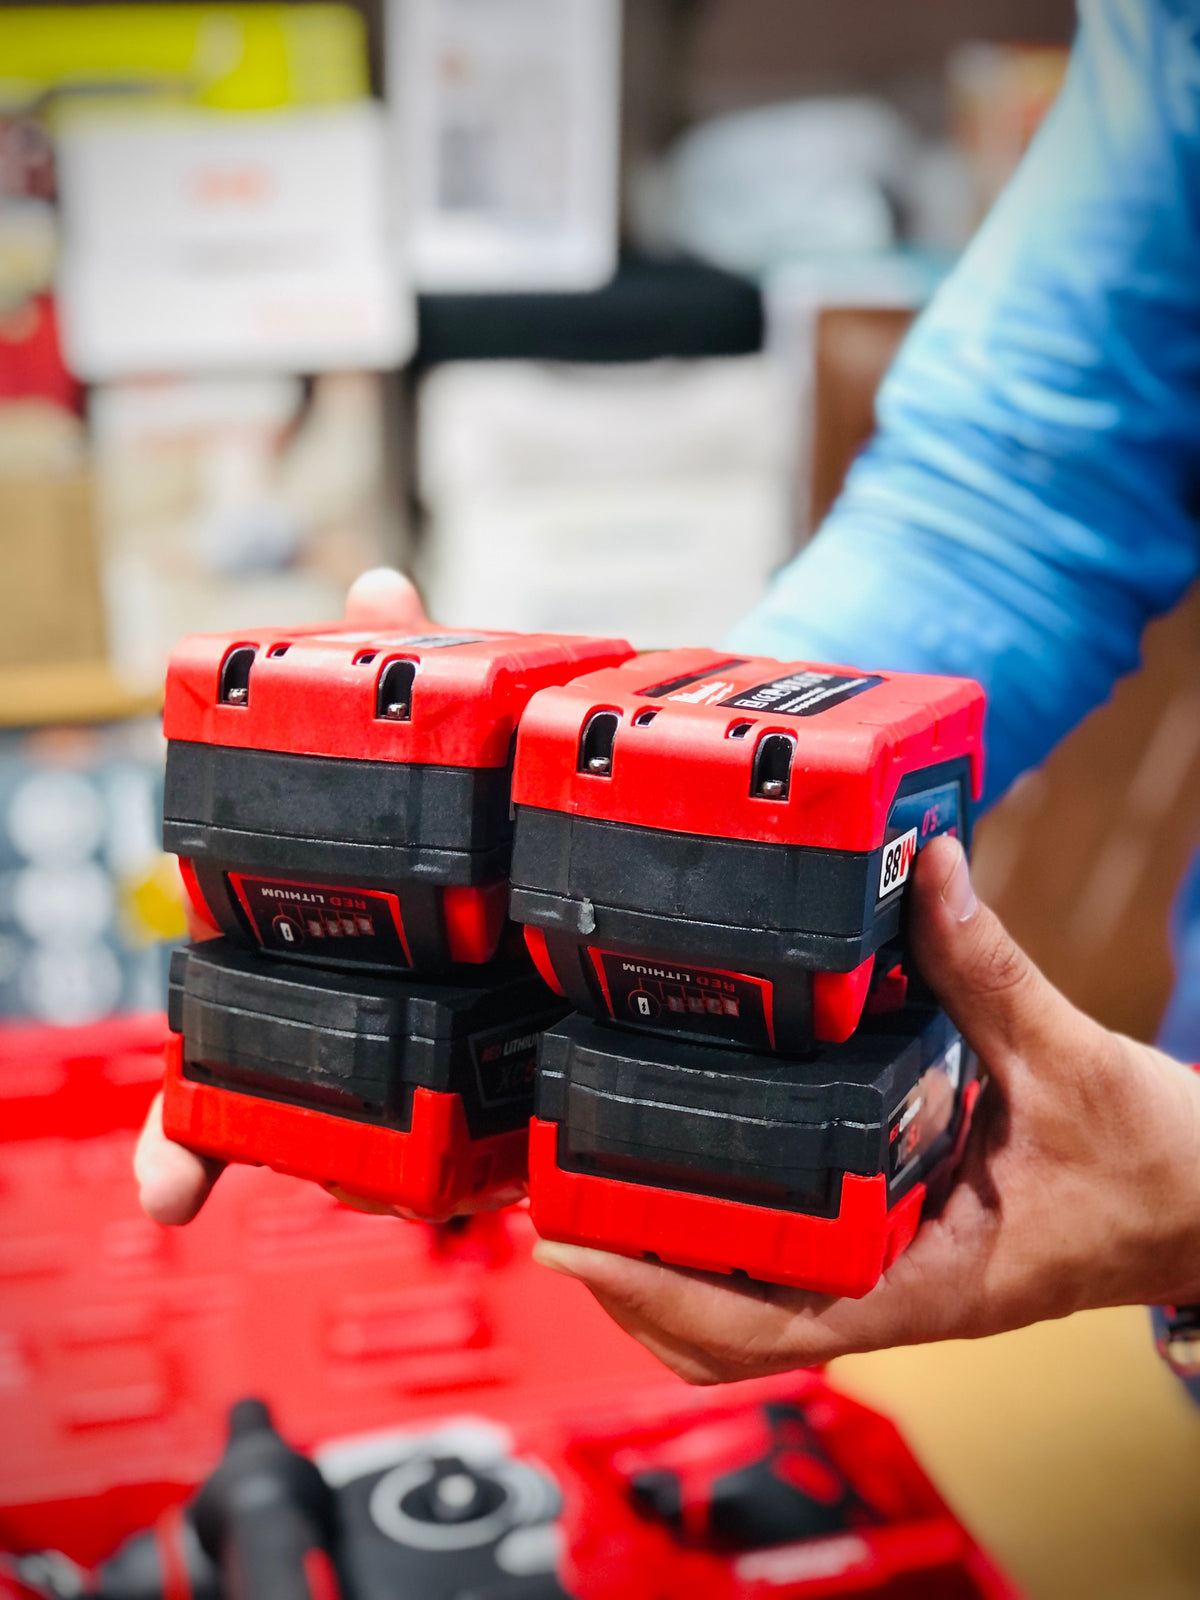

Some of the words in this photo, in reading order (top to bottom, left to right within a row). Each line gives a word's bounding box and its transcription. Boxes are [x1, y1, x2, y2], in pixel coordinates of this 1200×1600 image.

[884, 834, 915, 888] M88
[262, 888, 324, 904] LITHIUM
[330, 897, 366, 910] RED
[622, 963, 690, 982] LITHIUM
[696, 976, 735, 992] RED
